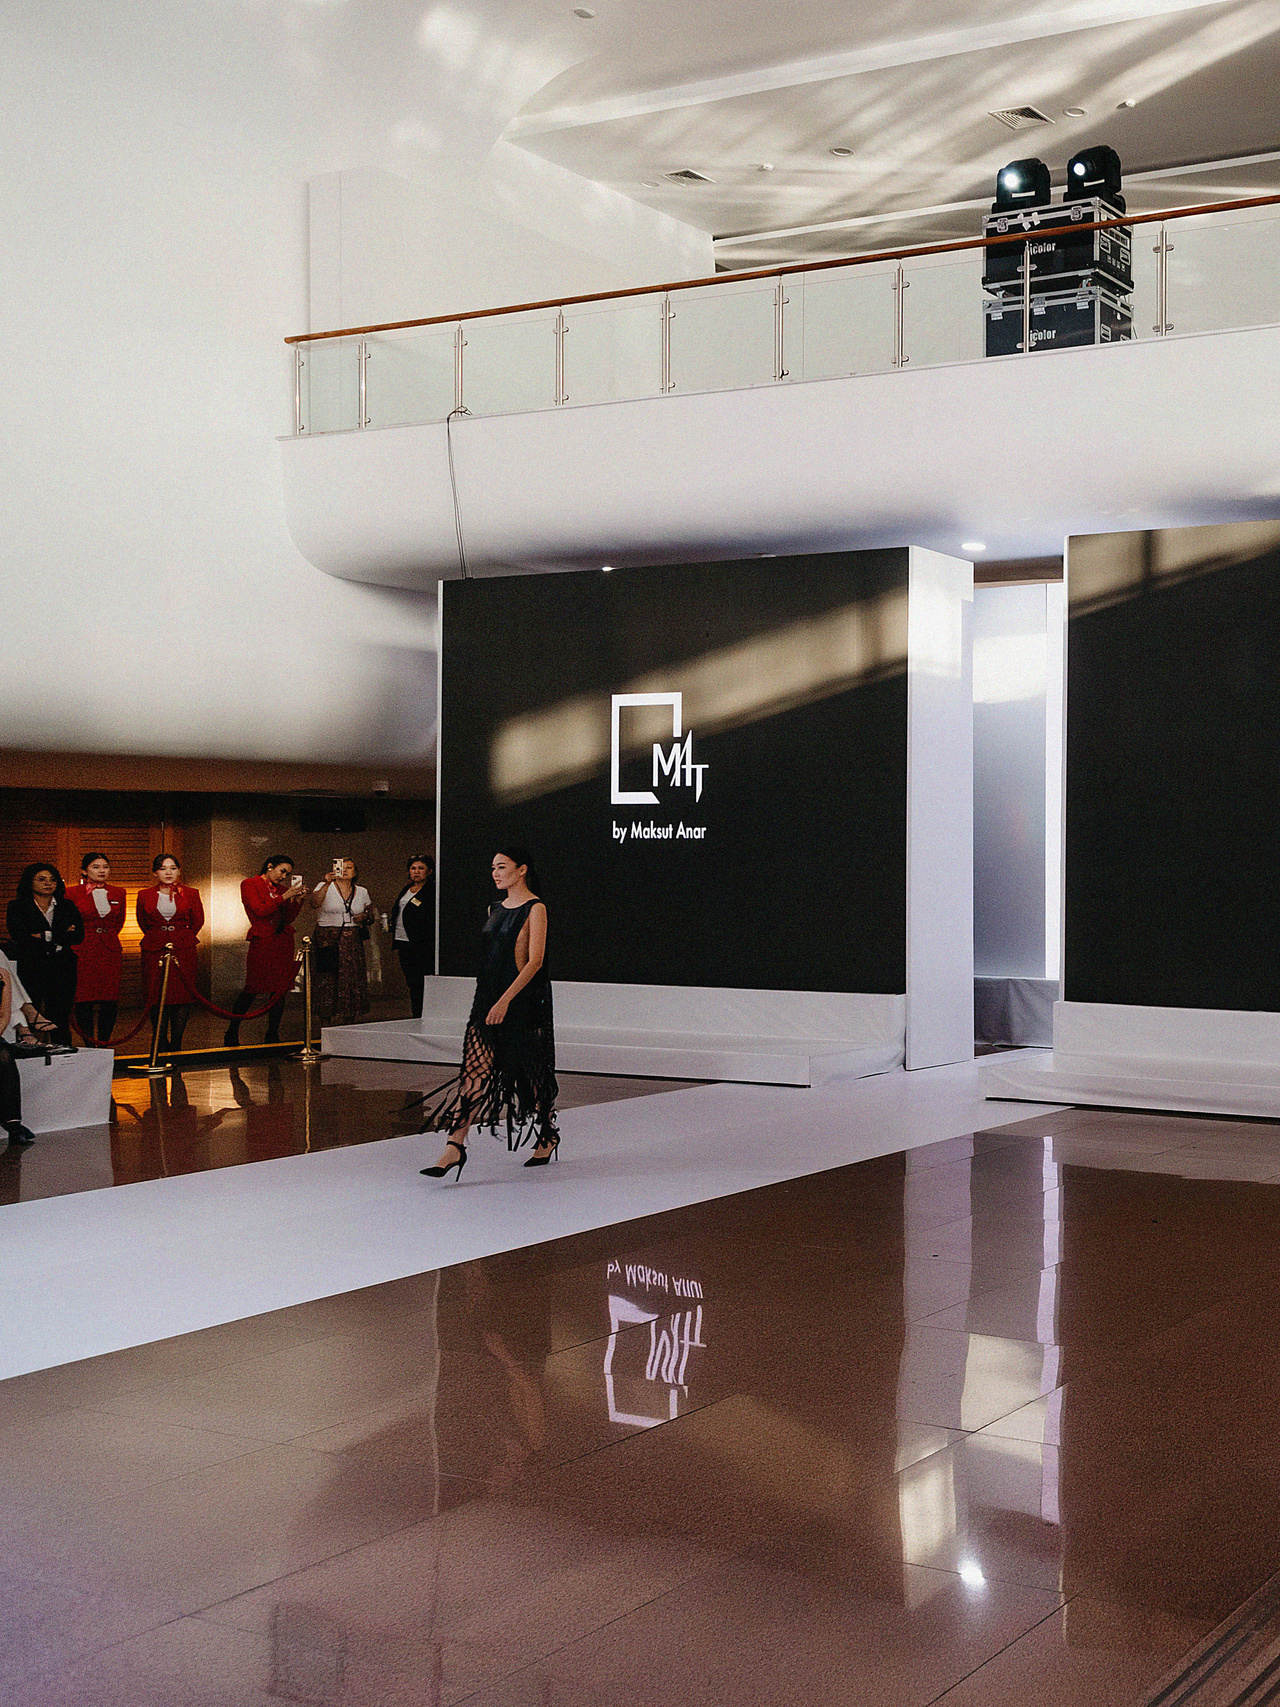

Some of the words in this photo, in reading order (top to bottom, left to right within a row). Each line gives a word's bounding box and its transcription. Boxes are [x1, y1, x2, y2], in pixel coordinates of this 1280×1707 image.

[1027, 242, 1056, 256] icolor
[1027, 330, 1057, 342] icolor
[612, 820, 628, 844] by
[630, 820, 674, 839] Maksut
[675, 820, 707, 839] Anar
